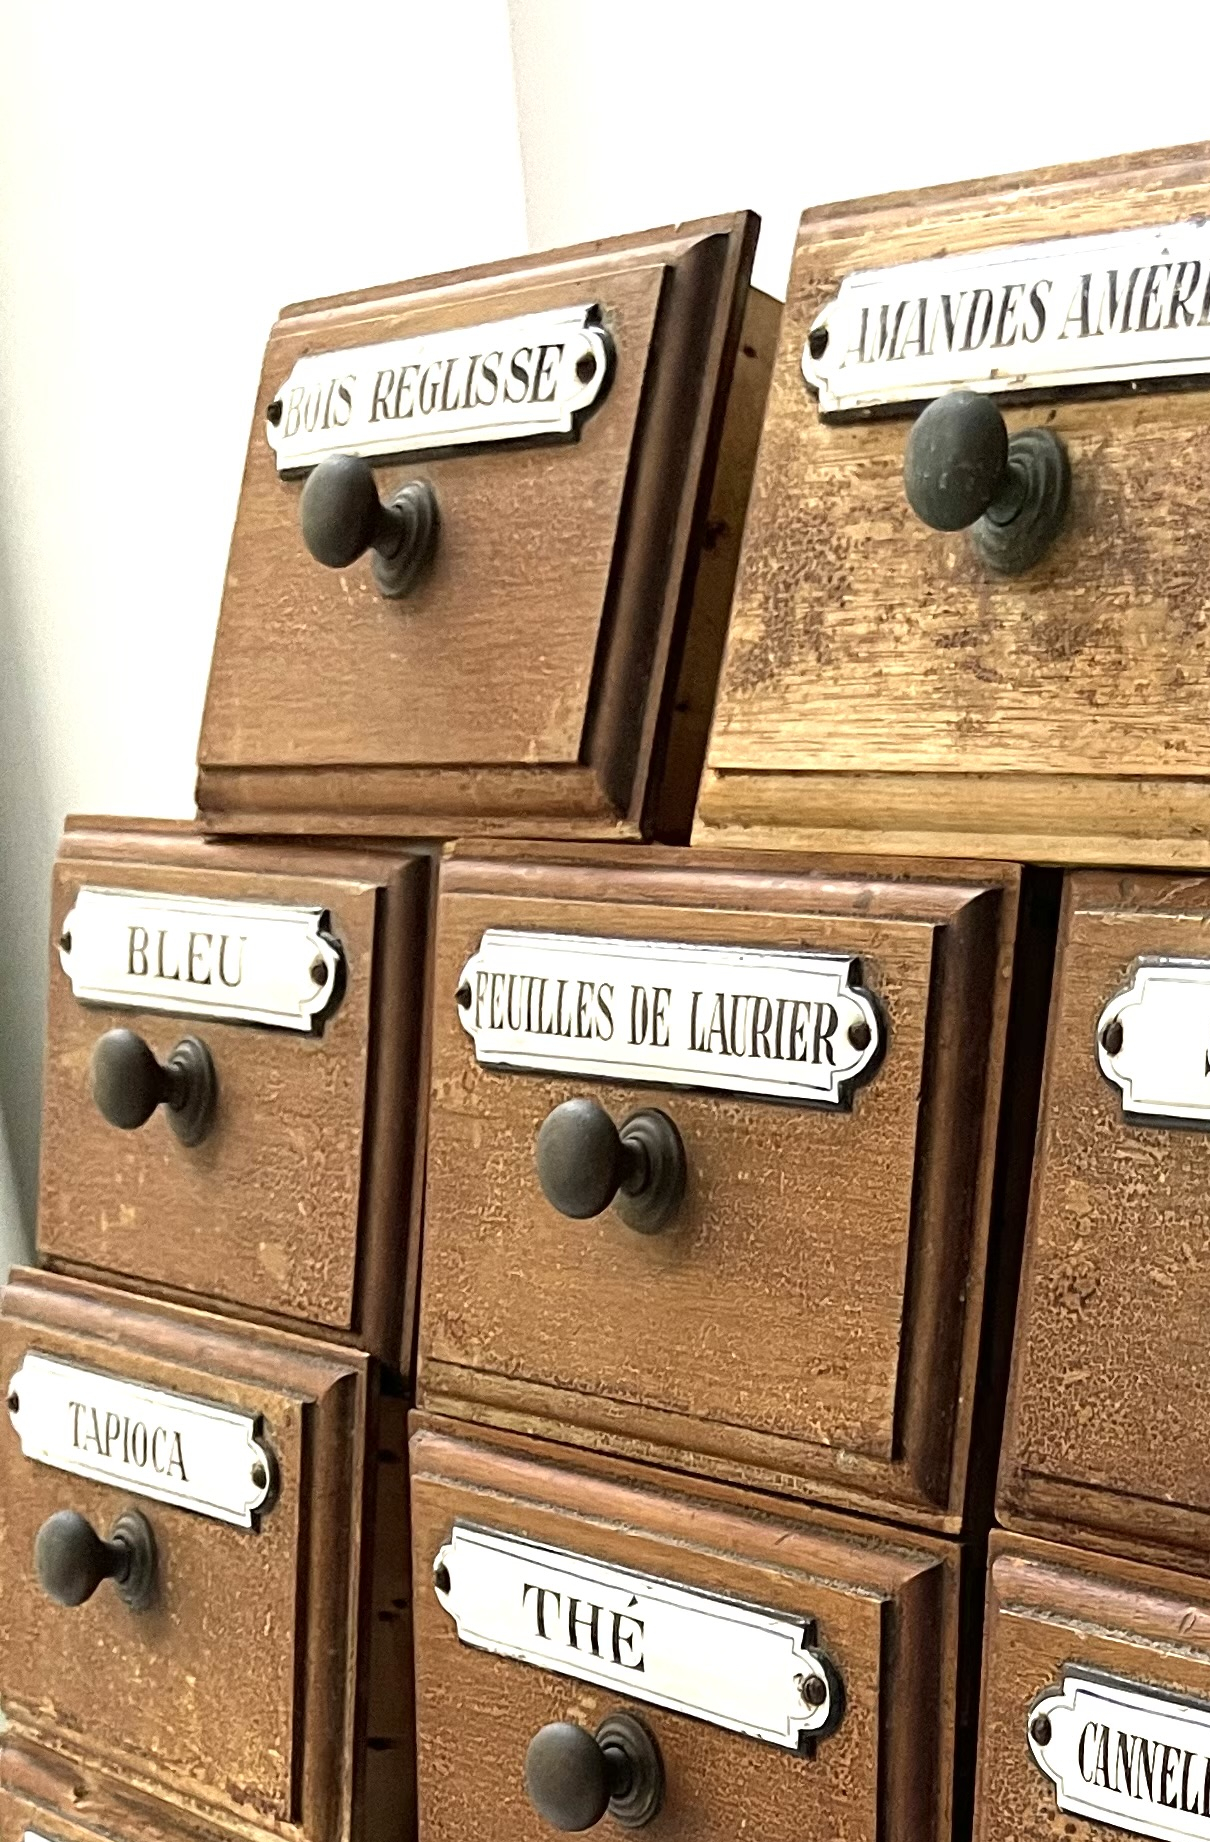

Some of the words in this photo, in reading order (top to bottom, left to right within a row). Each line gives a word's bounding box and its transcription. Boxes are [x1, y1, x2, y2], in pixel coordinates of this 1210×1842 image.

[840, 278, 1053, 369] AMANDES
[282, 373, 357, 440] BOIS
[126, 925, 248, 988] BLEU
[475, 970, 615, 1042] FEUILLES
[627, 984, 672, 1047] DE
[687, 990, 840, 1066] LAURIER
[68, 1400, 190, 1483] TAPIOCA
[522, 1582, 645, 1673] THÉ
